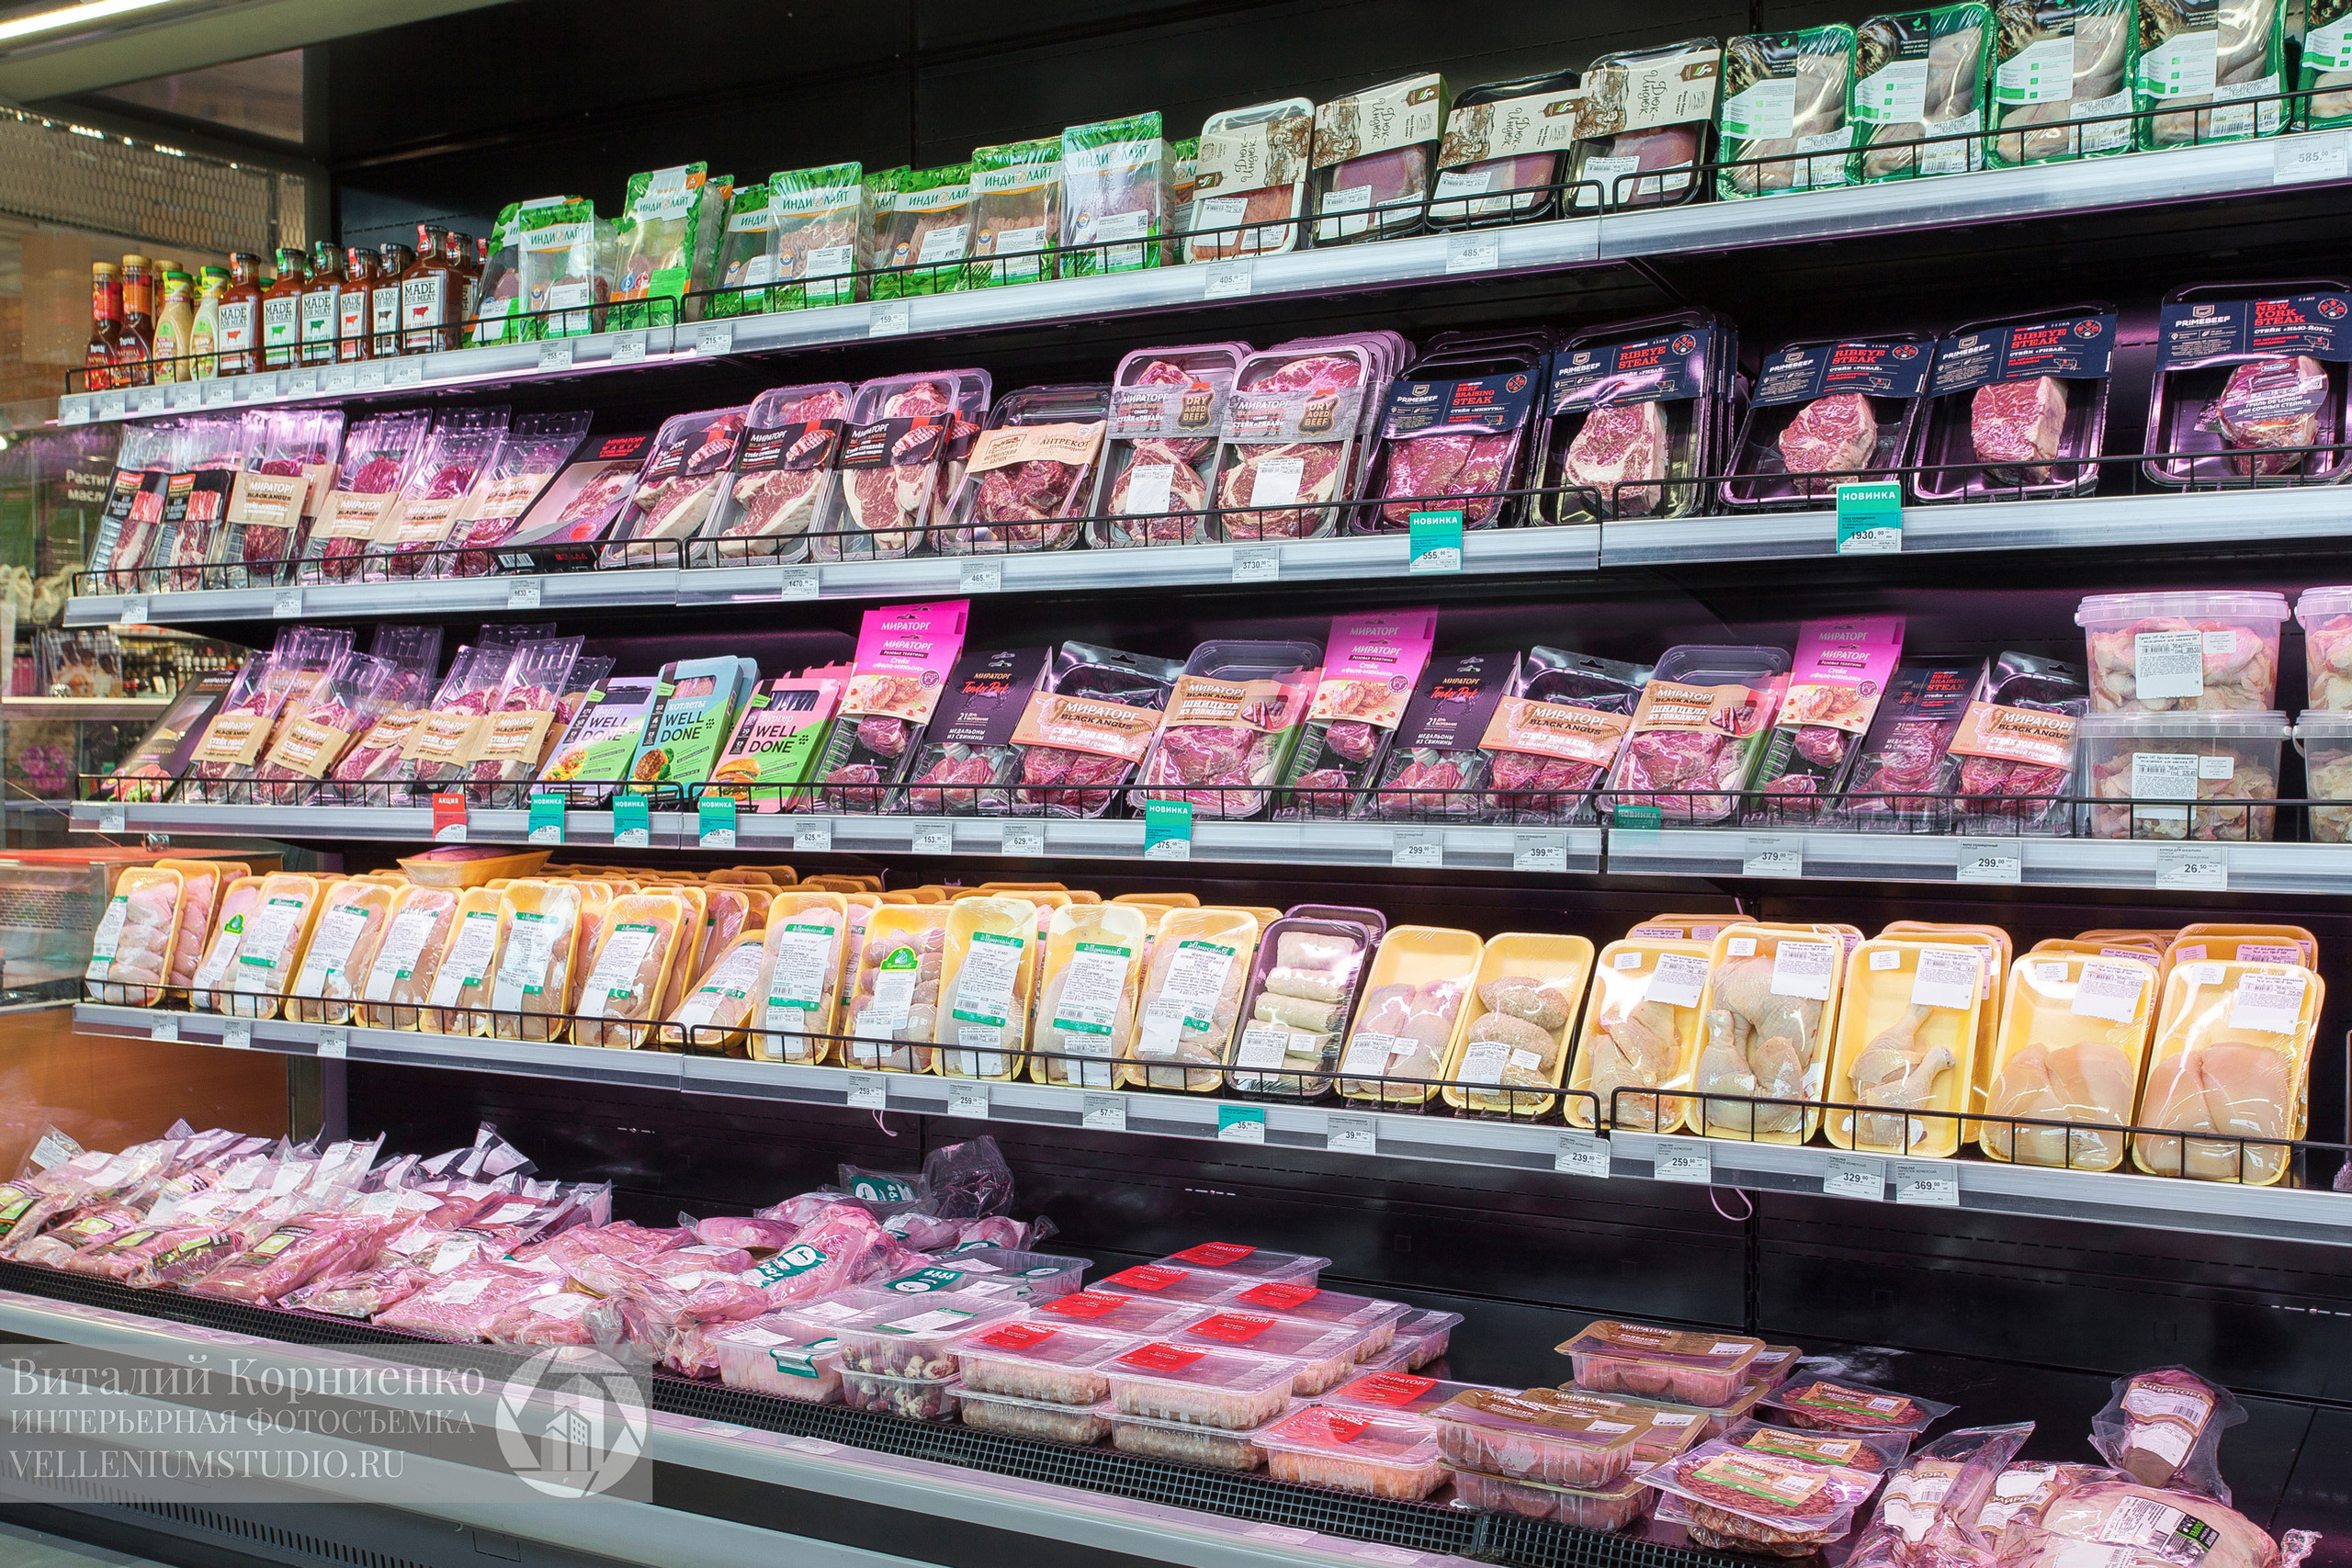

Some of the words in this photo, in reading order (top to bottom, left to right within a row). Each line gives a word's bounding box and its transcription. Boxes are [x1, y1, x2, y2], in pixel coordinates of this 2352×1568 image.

[405, 283, 435, 296] MADE
[342, 296, 361, 306] MADE
[374, 291, 396, 302] MADE
[415, 293, 435, 302] MEAT
[304, 297, 331, 308] MADE
[2256, 303, 2290, 312] NEW
[220, 308, 247, 320] MADE
[266, 303, 292, 314] MADE
[2256, 309, 2297, 318] YORK
[2176, 315, 2231, 327] PRIMEBEEF
[2254, 315, 2305, 326] STEAK
[2012, 328, 2067, 342] RIBEYE
[2010, 336, 2059, 349] STEAK
[1620, 346, 1667, 361] RIBEYE
[1835, 349, 1886, 357] RIBEYE
[1942, 344, 1990, 360] PRIMEBEEF
[1618, 356, 1659, 369] STEAK
[1832, 355, 1877, 365] STEAK
[1559, 362, 1600, 376] PRIMEBEEF
[1769, 359, 1814, 373] PRIMEBEEF
[1122, 392, 1169, 403] МИРАТОРГ
[1186, 396, 1207, 406] DRY
[1397, 395, 1438, 403] PRIMEBEEF
[1453, 396, 1493, 406] STEAK
[1185, 405, 1205, 414] AGED
[1238, 400, 1290, 410] МИРАТОРГ
[1308, 400, 1334, 411] DRY
[2245, 400, 2267, 408] ГРИЛЬ
[2251, 404, 2279, 412] СОЧНЫХ
[2280, 400, 2312, 409] СТЕЙКОВ
[1183, 412, 1205, 422] BEEF
[1305, 417, 1329, 426] BEEF
[852, 423, 889, 438] МИРАТОРГ
[751, 430, 788, 443] МИРАТОРГ
[1039, 438, 1091, 447] АНТРЕКОТ
[249, 481, 295, 493] МИРАТОРГ
[1842, 491, 1895, 502] НОВИНКА
[340, 499, 385, 511] МИРАТОРГ
[1413, 516, 1458, 525] НОВИНКА
[881, 621, 931, 631] МИРАТОРГ
[1350, 626, 1399, 636] МИРАТОРГ
[1818, 632, 1868, 641] МИРАТОРГ
[883, 640, 933, 651] МИРАТОРГ
[1352, 646, 1402, 655] МИРАТОРГ
[1821, 650, 1871, 660] МИРАТОРГ
[1189, 682, 1247, 695] МИРАТОРГ
[1657, 689, 1716, 701] МИРАТОРГ
[668, 700, 706, 711] котлеты
[1182, 699, 1240, 711] ШНИЦЕЛЬ
[1650, 705, 1708, 716] ШНИЦЕЛЬ
[1064, 702, 1139, 722] МИРАТОРГ
[1532, 706, 1608, 728] МИРАТОРГ
[500, 716, 539, 727] МИРАТОРГ
[589, 716, 628, 728] WELL
[665, 711, 705, 727] WELL
[760, 714, 795, 727] бургер
[1060, 713, 1096, 725] BLACK
[1097, 719, 1133, 730] ANGUS
[2002, 711, 2075, 729] МИРАТОРГ
[755, 725, 798, 739] WELL
[1529, 717, 1566, 729] BLACK
[1566, 723, 1601, 736] ANGUS
[1997, 723, 2032, 734] BLACK
[2033, 728, 2071, 740] ANGUS
[580, 729, 622, 742] DONE
[660, 728, 701, 743] DONE
[748, 741, 794, 753] DONE
[1149, 805, 1188, 815] НОВИНКА
[1619, 810, 1657, 819] НОВИНКА
[1620, 1324, 1673, 1336] МИРАТОРГ
[2141, 1382, 2204, 1400] МИРАТОРГ
